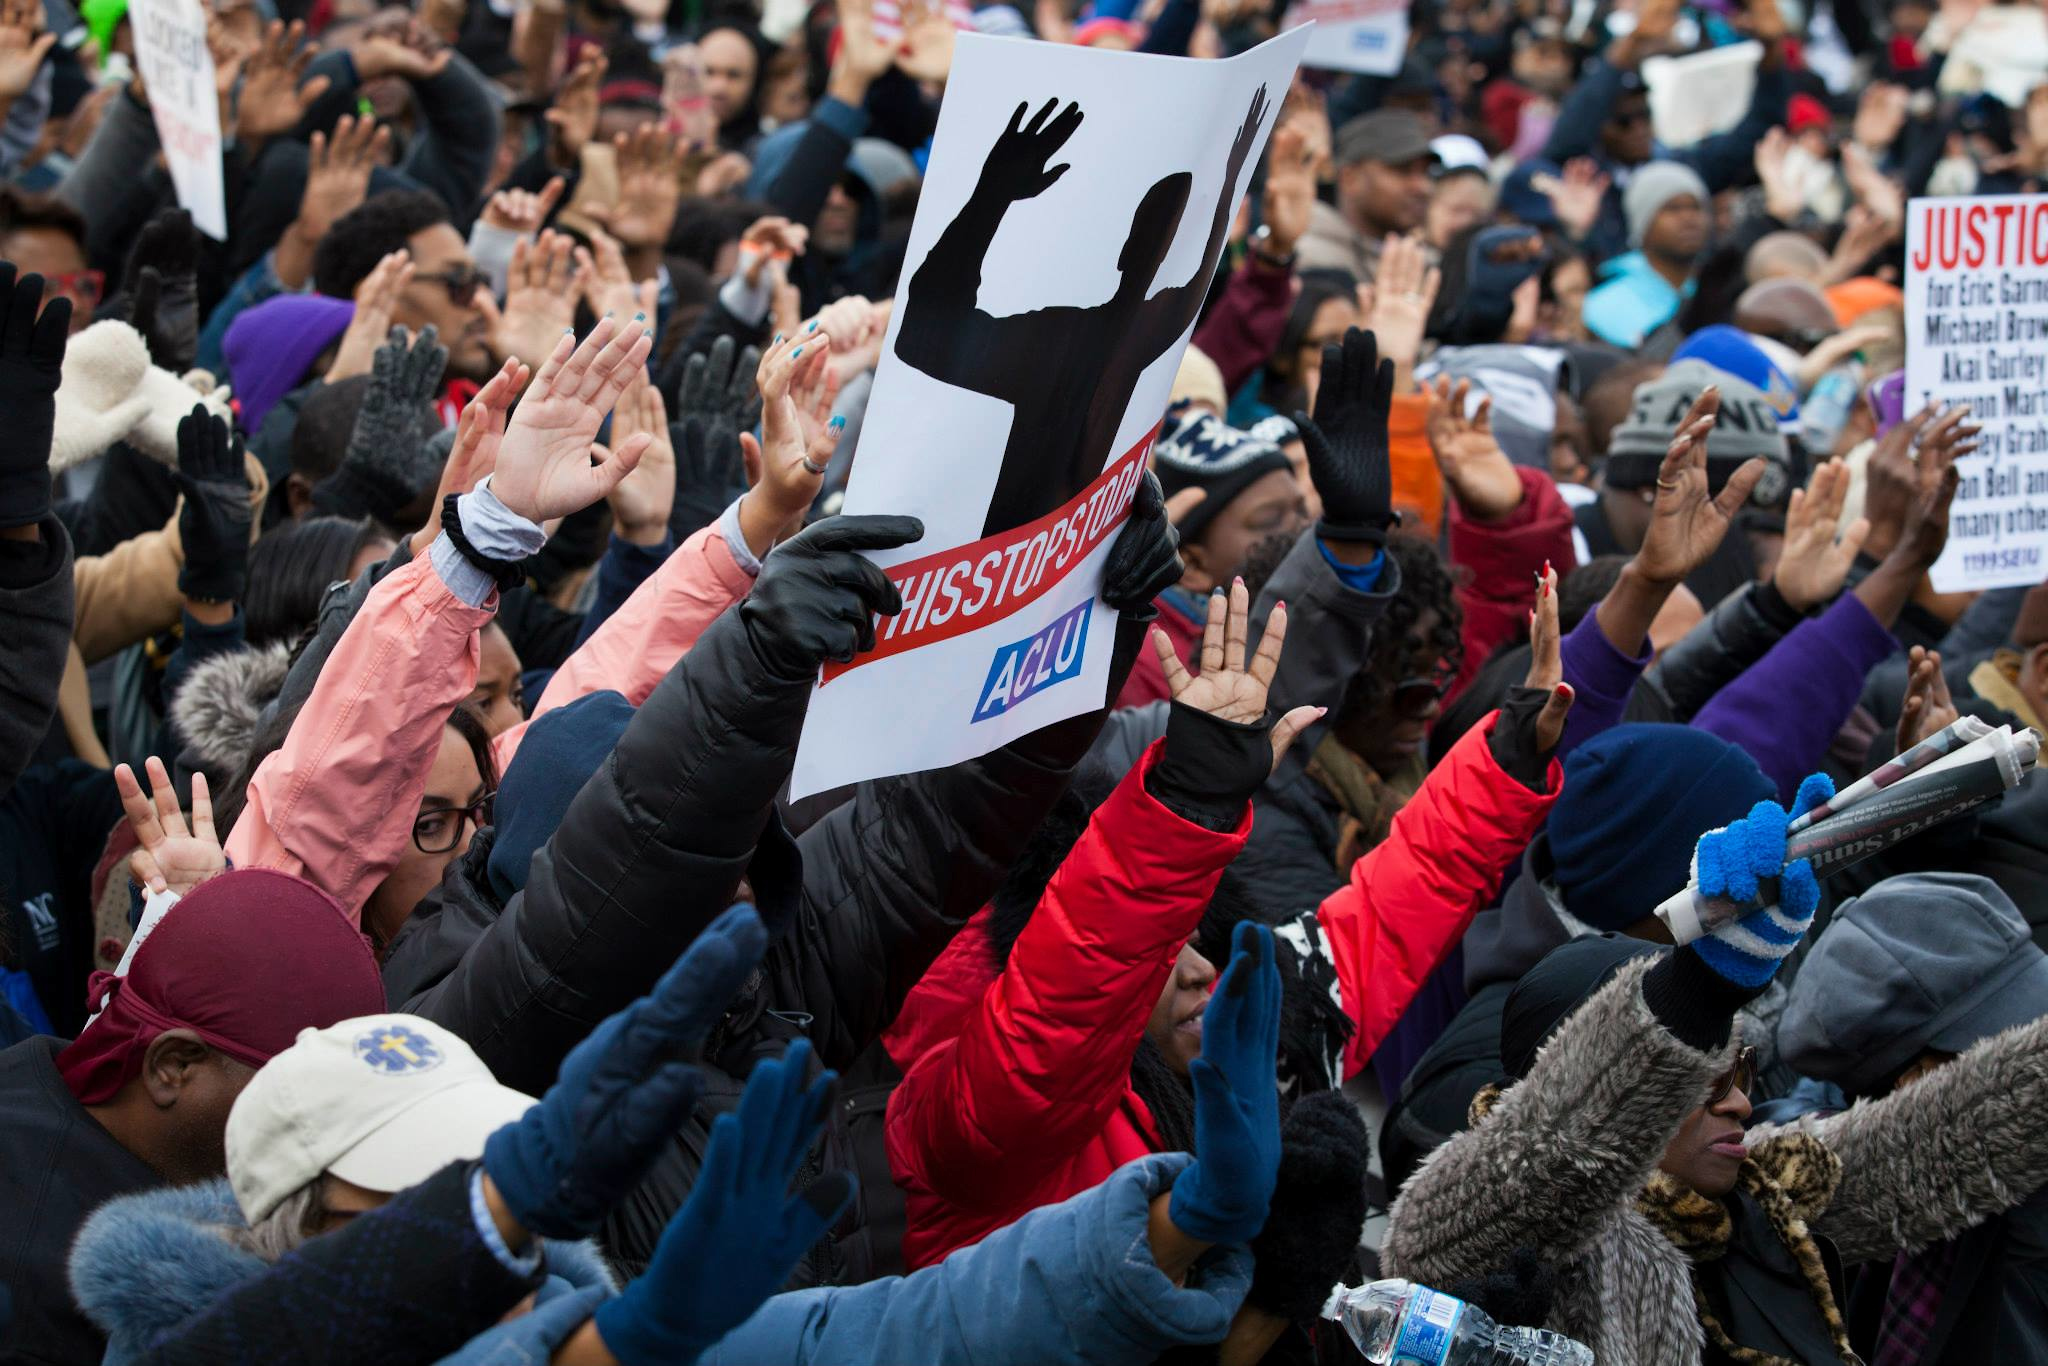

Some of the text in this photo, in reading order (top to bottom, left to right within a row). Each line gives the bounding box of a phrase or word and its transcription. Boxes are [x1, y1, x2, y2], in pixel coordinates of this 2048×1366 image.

[1928, 275, 1953, 308] for
[1959, 273, 1994, 307] Eric
[1925, 312, 1999, 347] Michael
[1942, 348, 2045, 387] Akai Gurley
[1986, 466, 2019, 498] Bell
[2026, 471, 2048, 495] an
[873, 438, 1154, 641] HISSTOPSTODA
[1953, 512, 2000, 544] many
[980, 608, 1087, 714] ACLU
[1810, 834, 1885, 870] Sant
